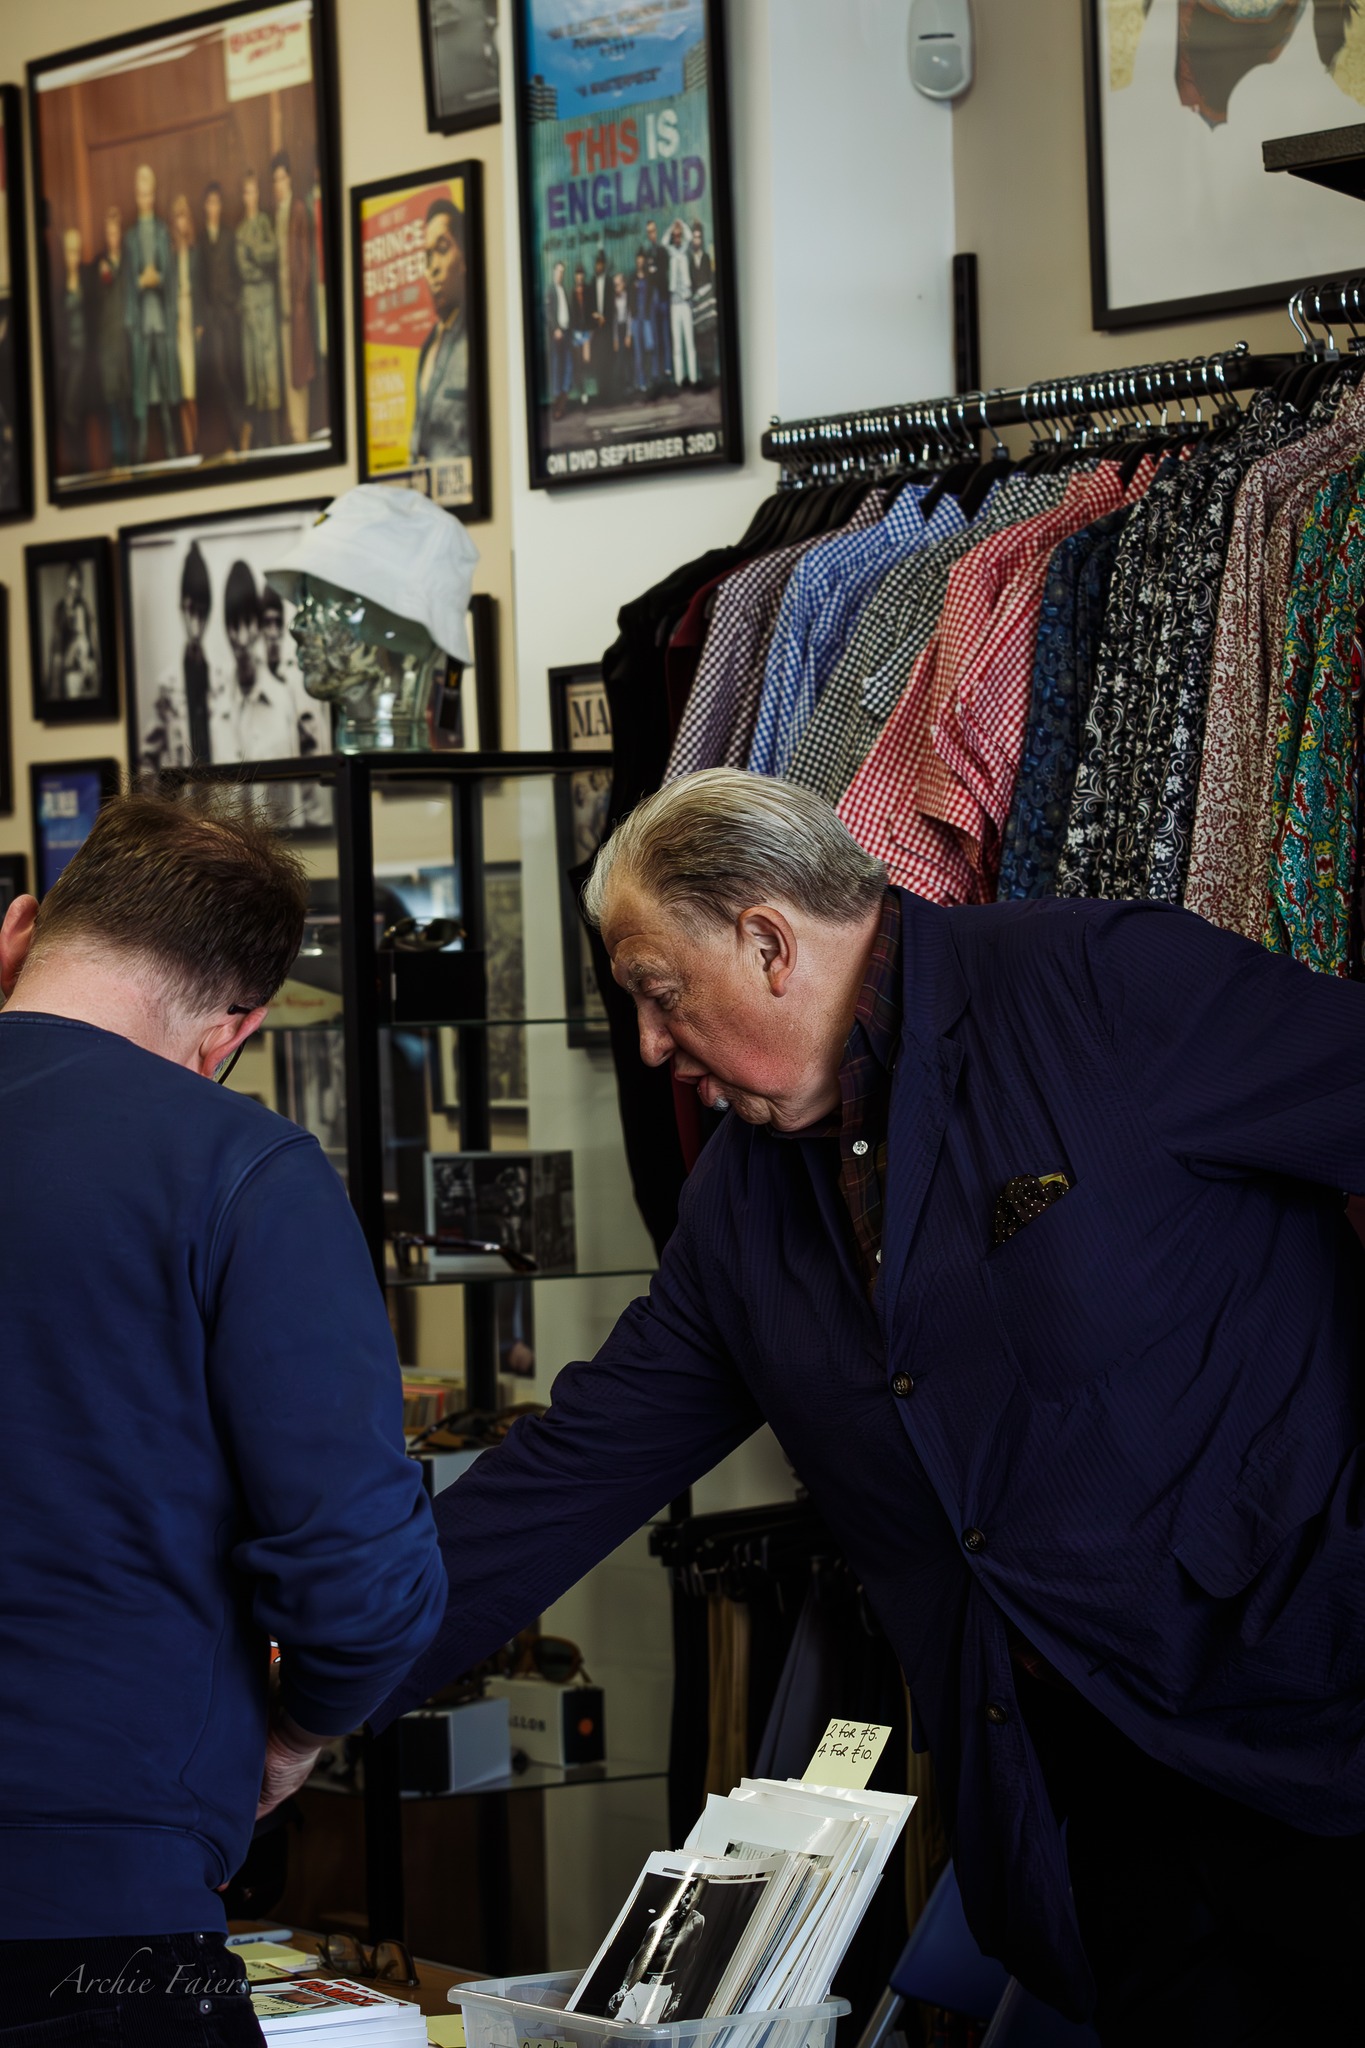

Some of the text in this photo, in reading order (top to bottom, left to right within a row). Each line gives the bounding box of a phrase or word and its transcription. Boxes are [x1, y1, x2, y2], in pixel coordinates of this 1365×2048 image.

[564, 108, 681, 176] THIS IS
[547, 155, 706, 230] ENGLAND
[364, 217, 426, 266] PRINCE
[364, 250, 428, 297] BUSTER
[546, 453, 568, 475] ON
[569, 448, 598, 472] DVD
[599, 437, 684, 467] SEPTEMBER
[686, 432, 717, 456] 3RD
[817, 1743, 828, 1758] 4
[825, 1723, 838, 1739] 2
